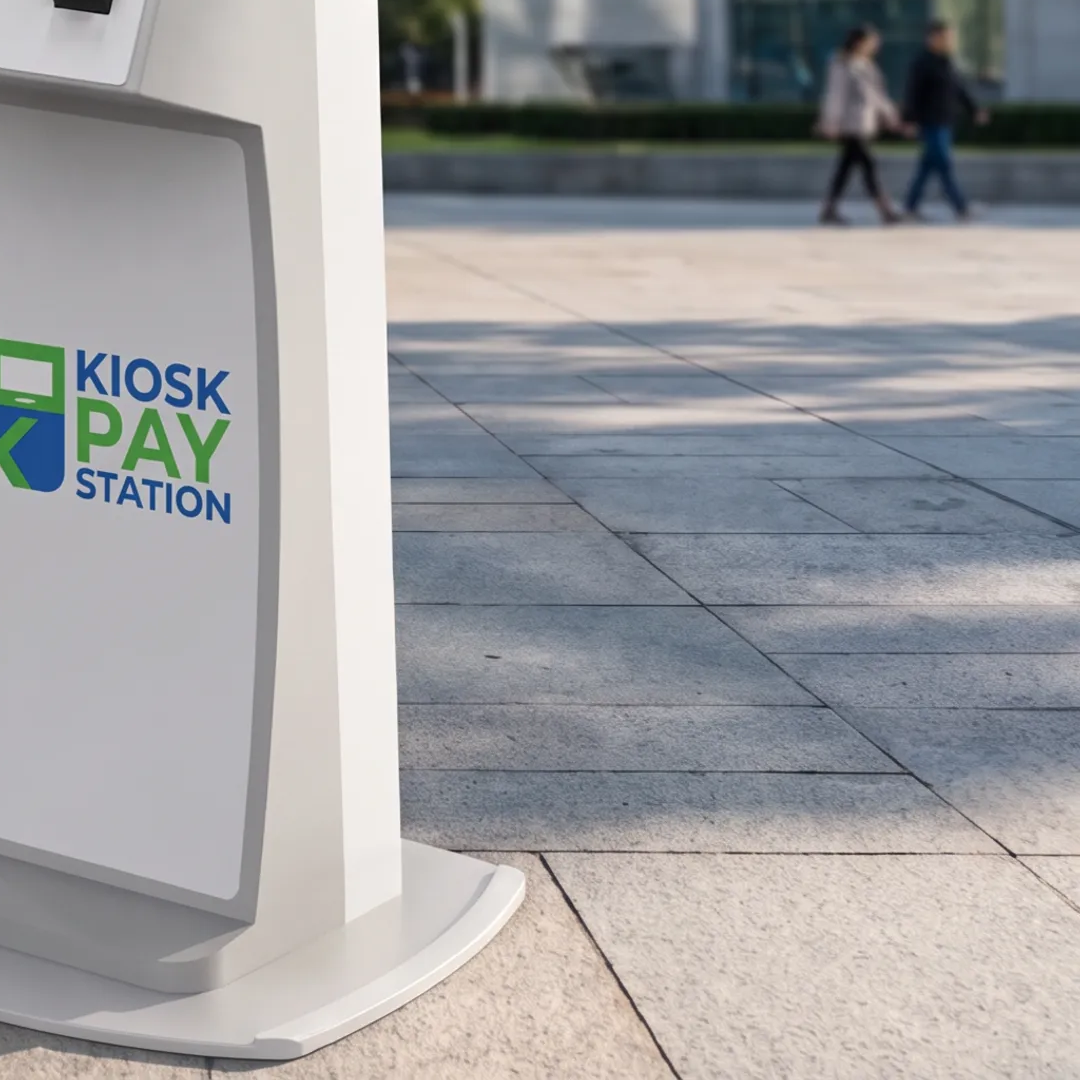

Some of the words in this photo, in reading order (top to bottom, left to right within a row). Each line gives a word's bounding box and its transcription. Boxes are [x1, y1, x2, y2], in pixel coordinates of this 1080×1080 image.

[76, 349, 231, 415] KIOSK
[76, 396, 231, 484] PAY
[75, 467, 231, 525] STATION
